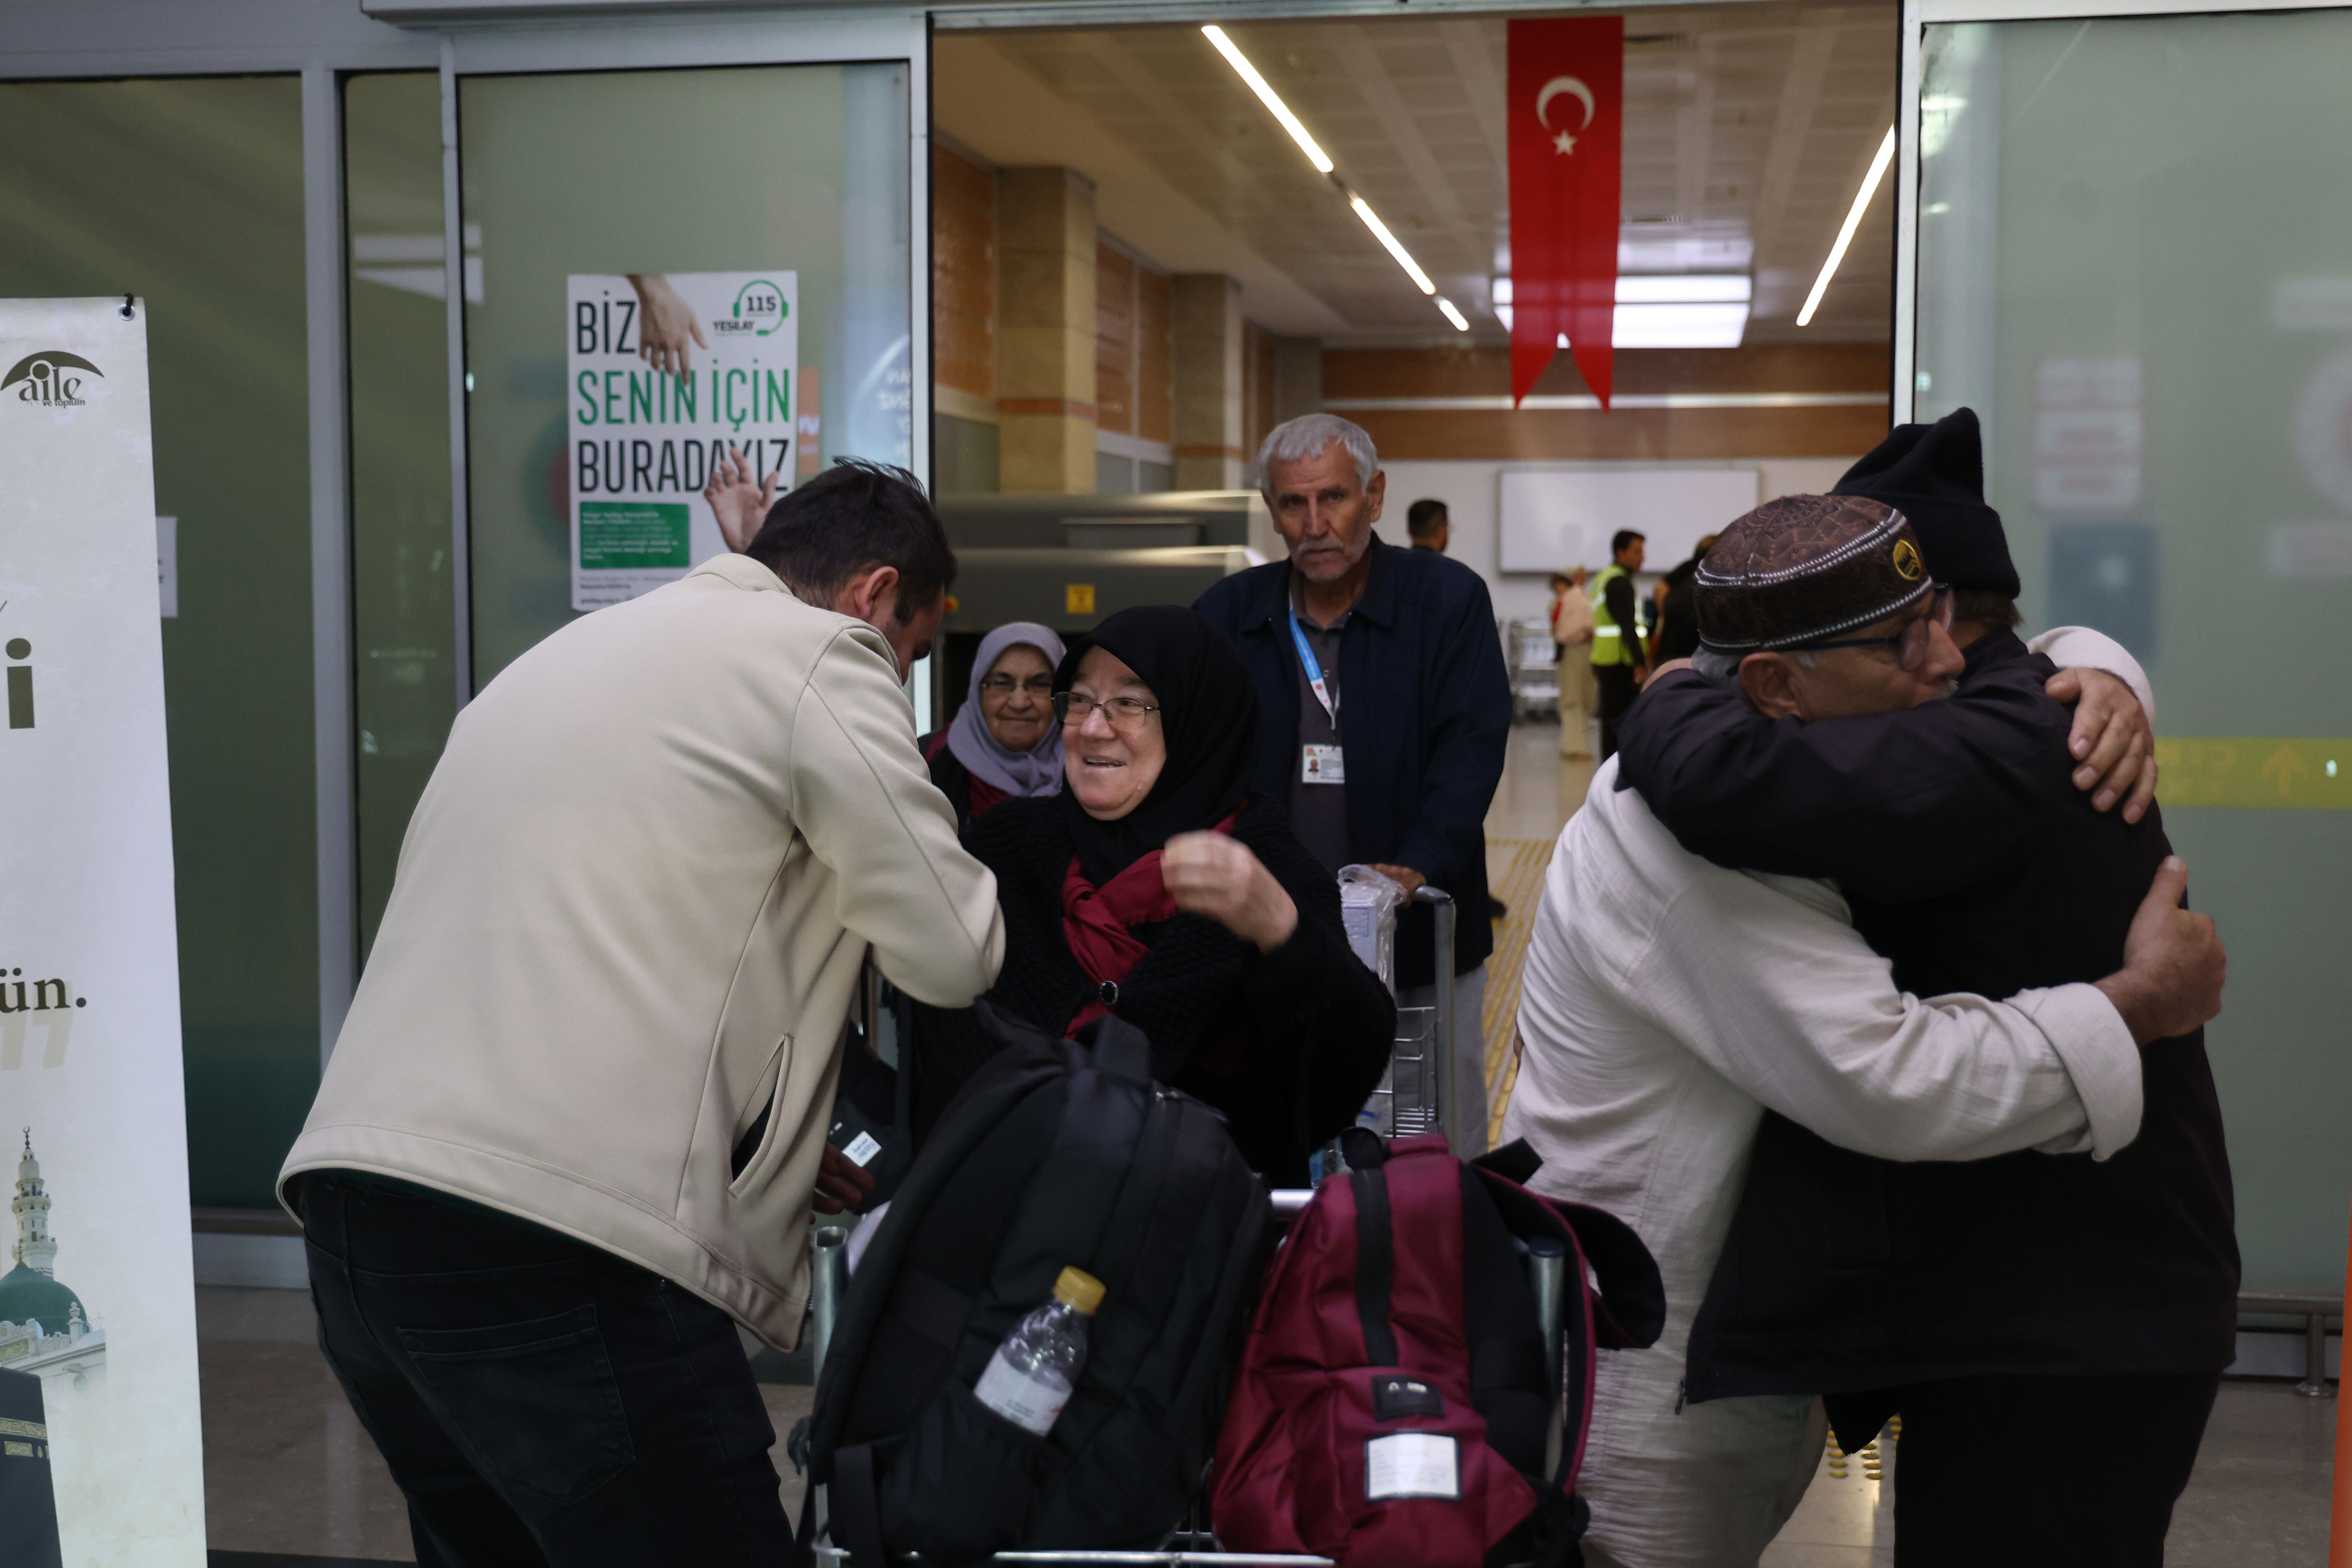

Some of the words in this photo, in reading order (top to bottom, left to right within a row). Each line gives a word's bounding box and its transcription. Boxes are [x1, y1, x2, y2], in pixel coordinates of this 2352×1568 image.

[577, 291, 637, 354] BİZ
[747, 296, 776, 312] 115
[19, 363, 82, 401] aile
[577, 361, 696, 426] SENİN
[712, 359, 790, 432] İÇİN
